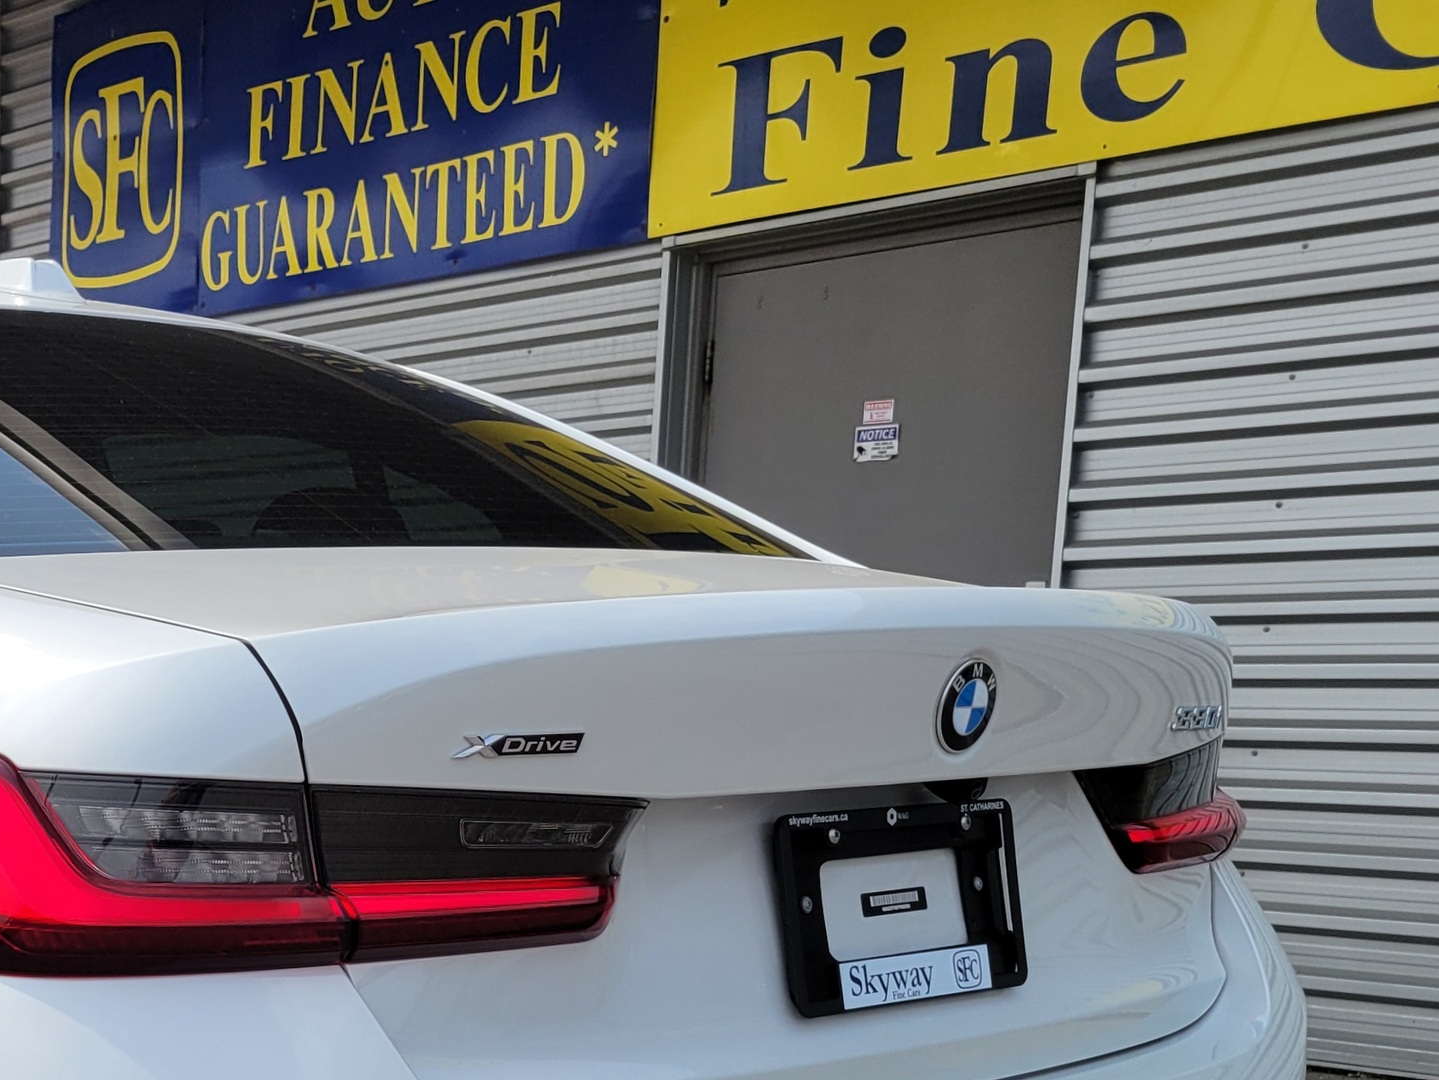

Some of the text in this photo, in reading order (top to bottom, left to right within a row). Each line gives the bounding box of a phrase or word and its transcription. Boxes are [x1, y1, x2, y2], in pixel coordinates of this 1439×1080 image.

[244, 1, 561, 169] FINANCE
[710, 11, 1187, 197] Fine
[70, 77, 174, 251] SFC
[859, 429, 896, 441] NOTICE
[788, 813, 849, 827] skywayfinecars.ca
[969, 801, 1004, 812] CATHARINES
[849, 964, 934, 1002] Skyway
[956, 956, 980, 983] SFC
[892, 988, 921, 1000] Fine Cars
